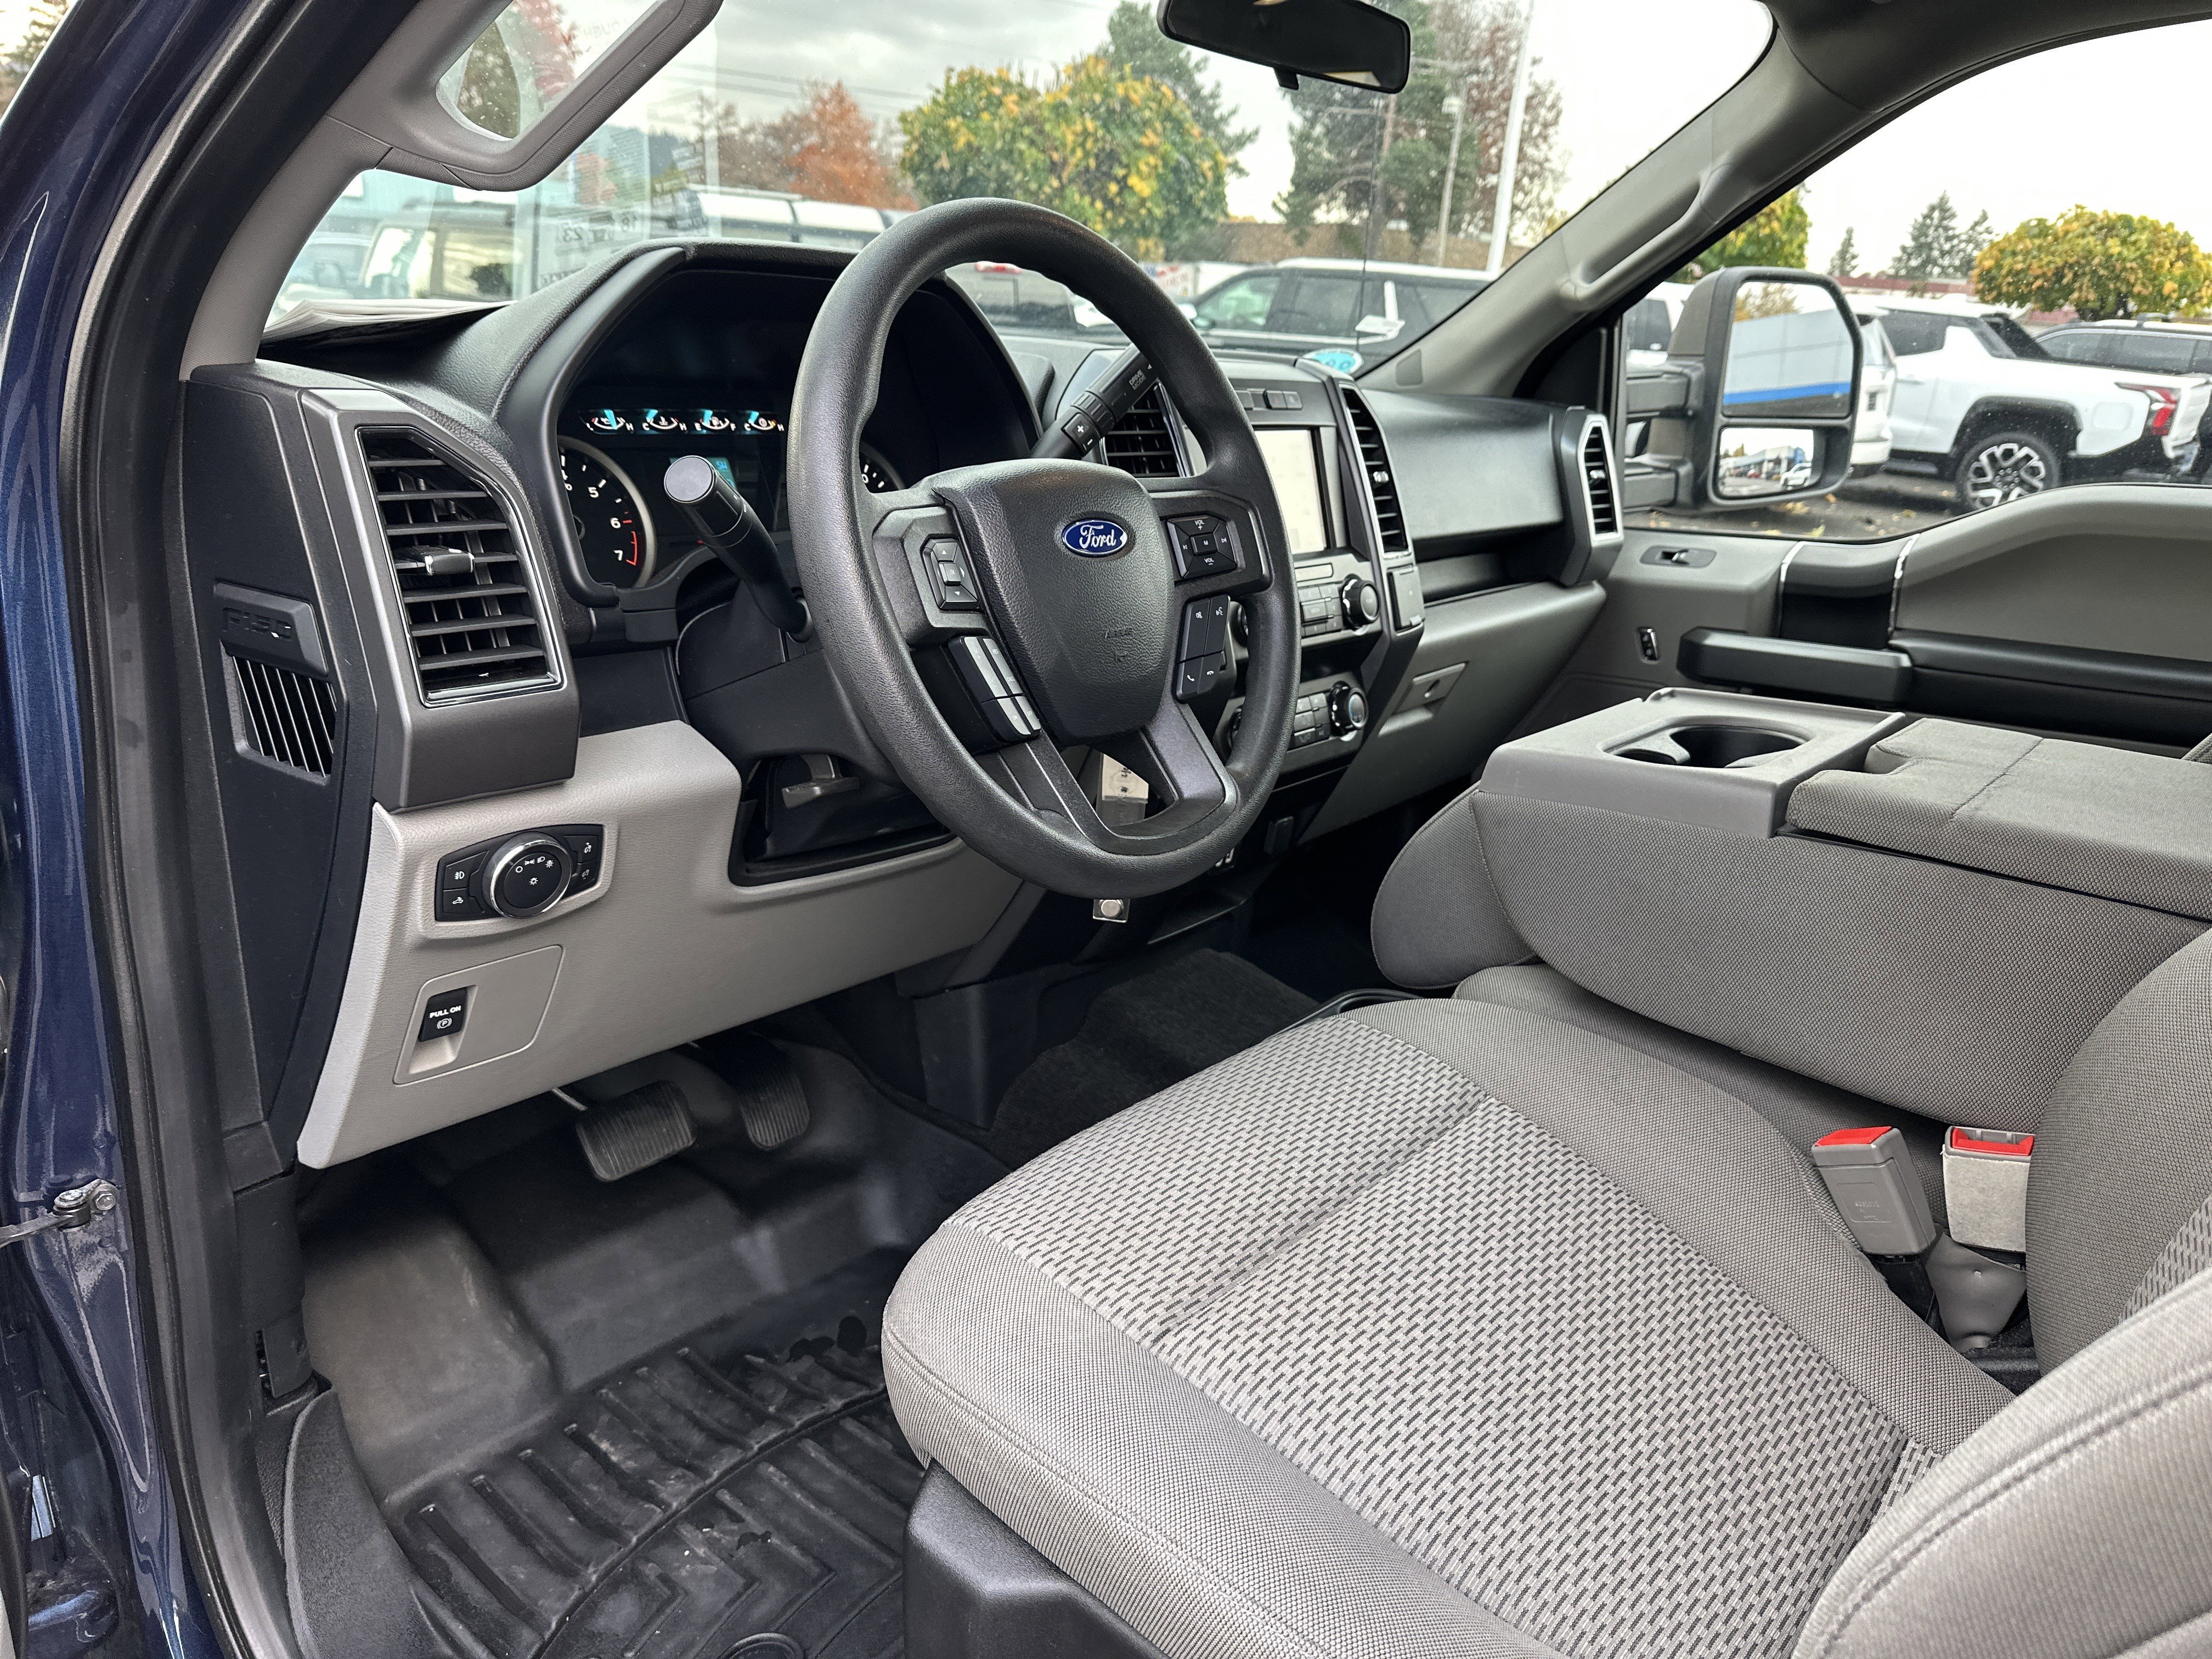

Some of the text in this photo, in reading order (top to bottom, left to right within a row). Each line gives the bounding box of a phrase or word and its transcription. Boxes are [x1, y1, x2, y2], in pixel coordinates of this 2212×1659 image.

[1128, 369, 1143, 386] DRIVE
[1132, 374, 1147, 391] MODE
[625, 422, 634, 431] H
[642, 422, 687, 431] C H
[694, 422, 702, 431] E
[744, 422, 785, 431] C H
[588, 486, 599, 498] 5
[610, 517, 621, 529] 6
[1079, 524, 1116, 549] Ford
[613, 549, 623, 561] 7
[429, 1005, 461, 1019] PULL ON
